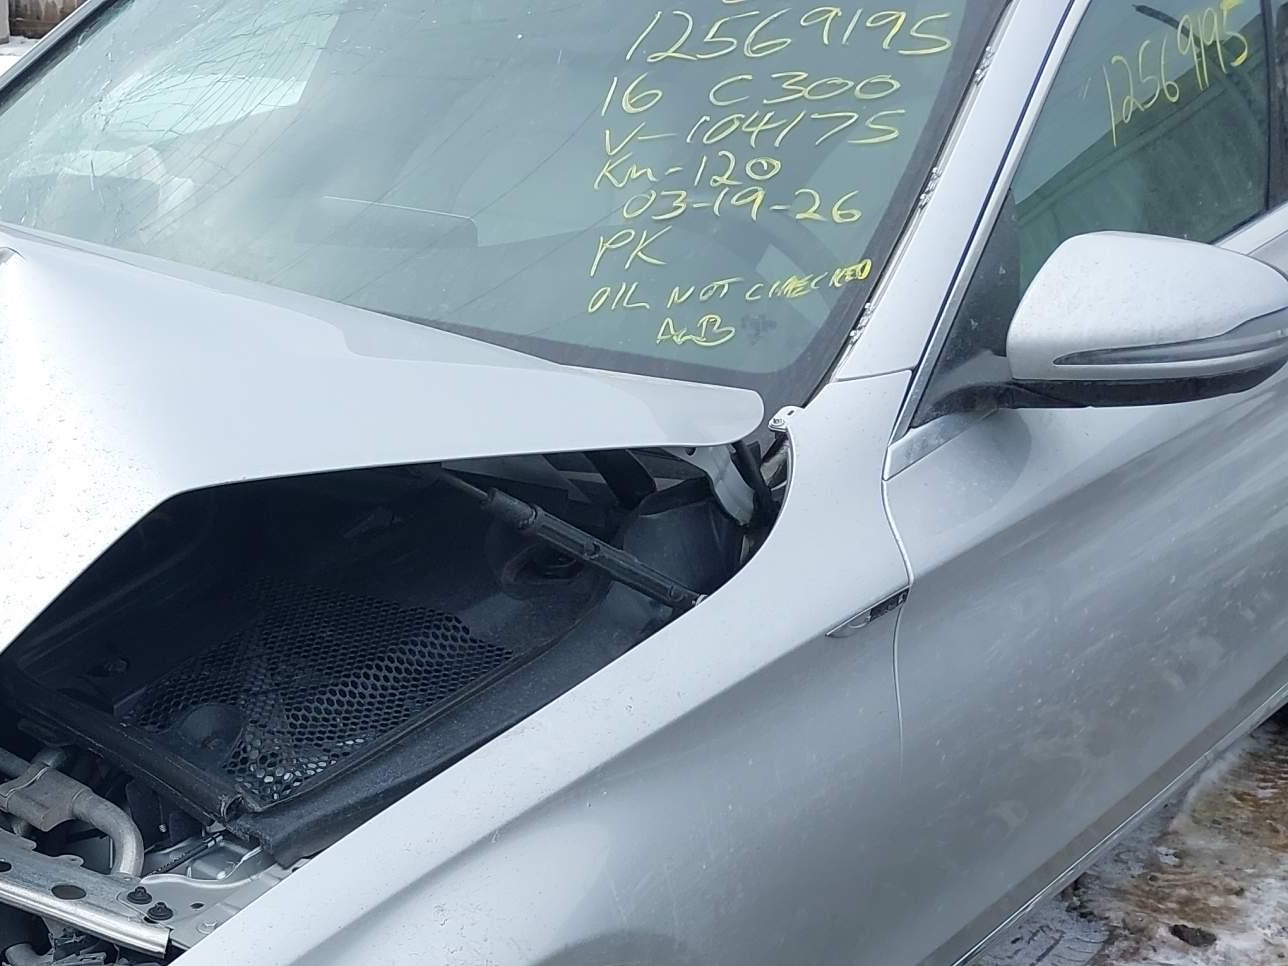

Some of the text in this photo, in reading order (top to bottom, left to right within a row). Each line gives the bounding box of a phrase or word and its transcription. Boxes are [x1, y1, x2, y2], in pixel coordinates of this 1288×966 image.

[625, 7, 953, 63] 12569195
[601, 72, 663, 117] 16
[1103, 7, 1248, 148] 12569195
[622, 186, 863, 223] 03-19-26
[587, 281, 650, 313] OIL
[666, 277, 745, 308] NOT
